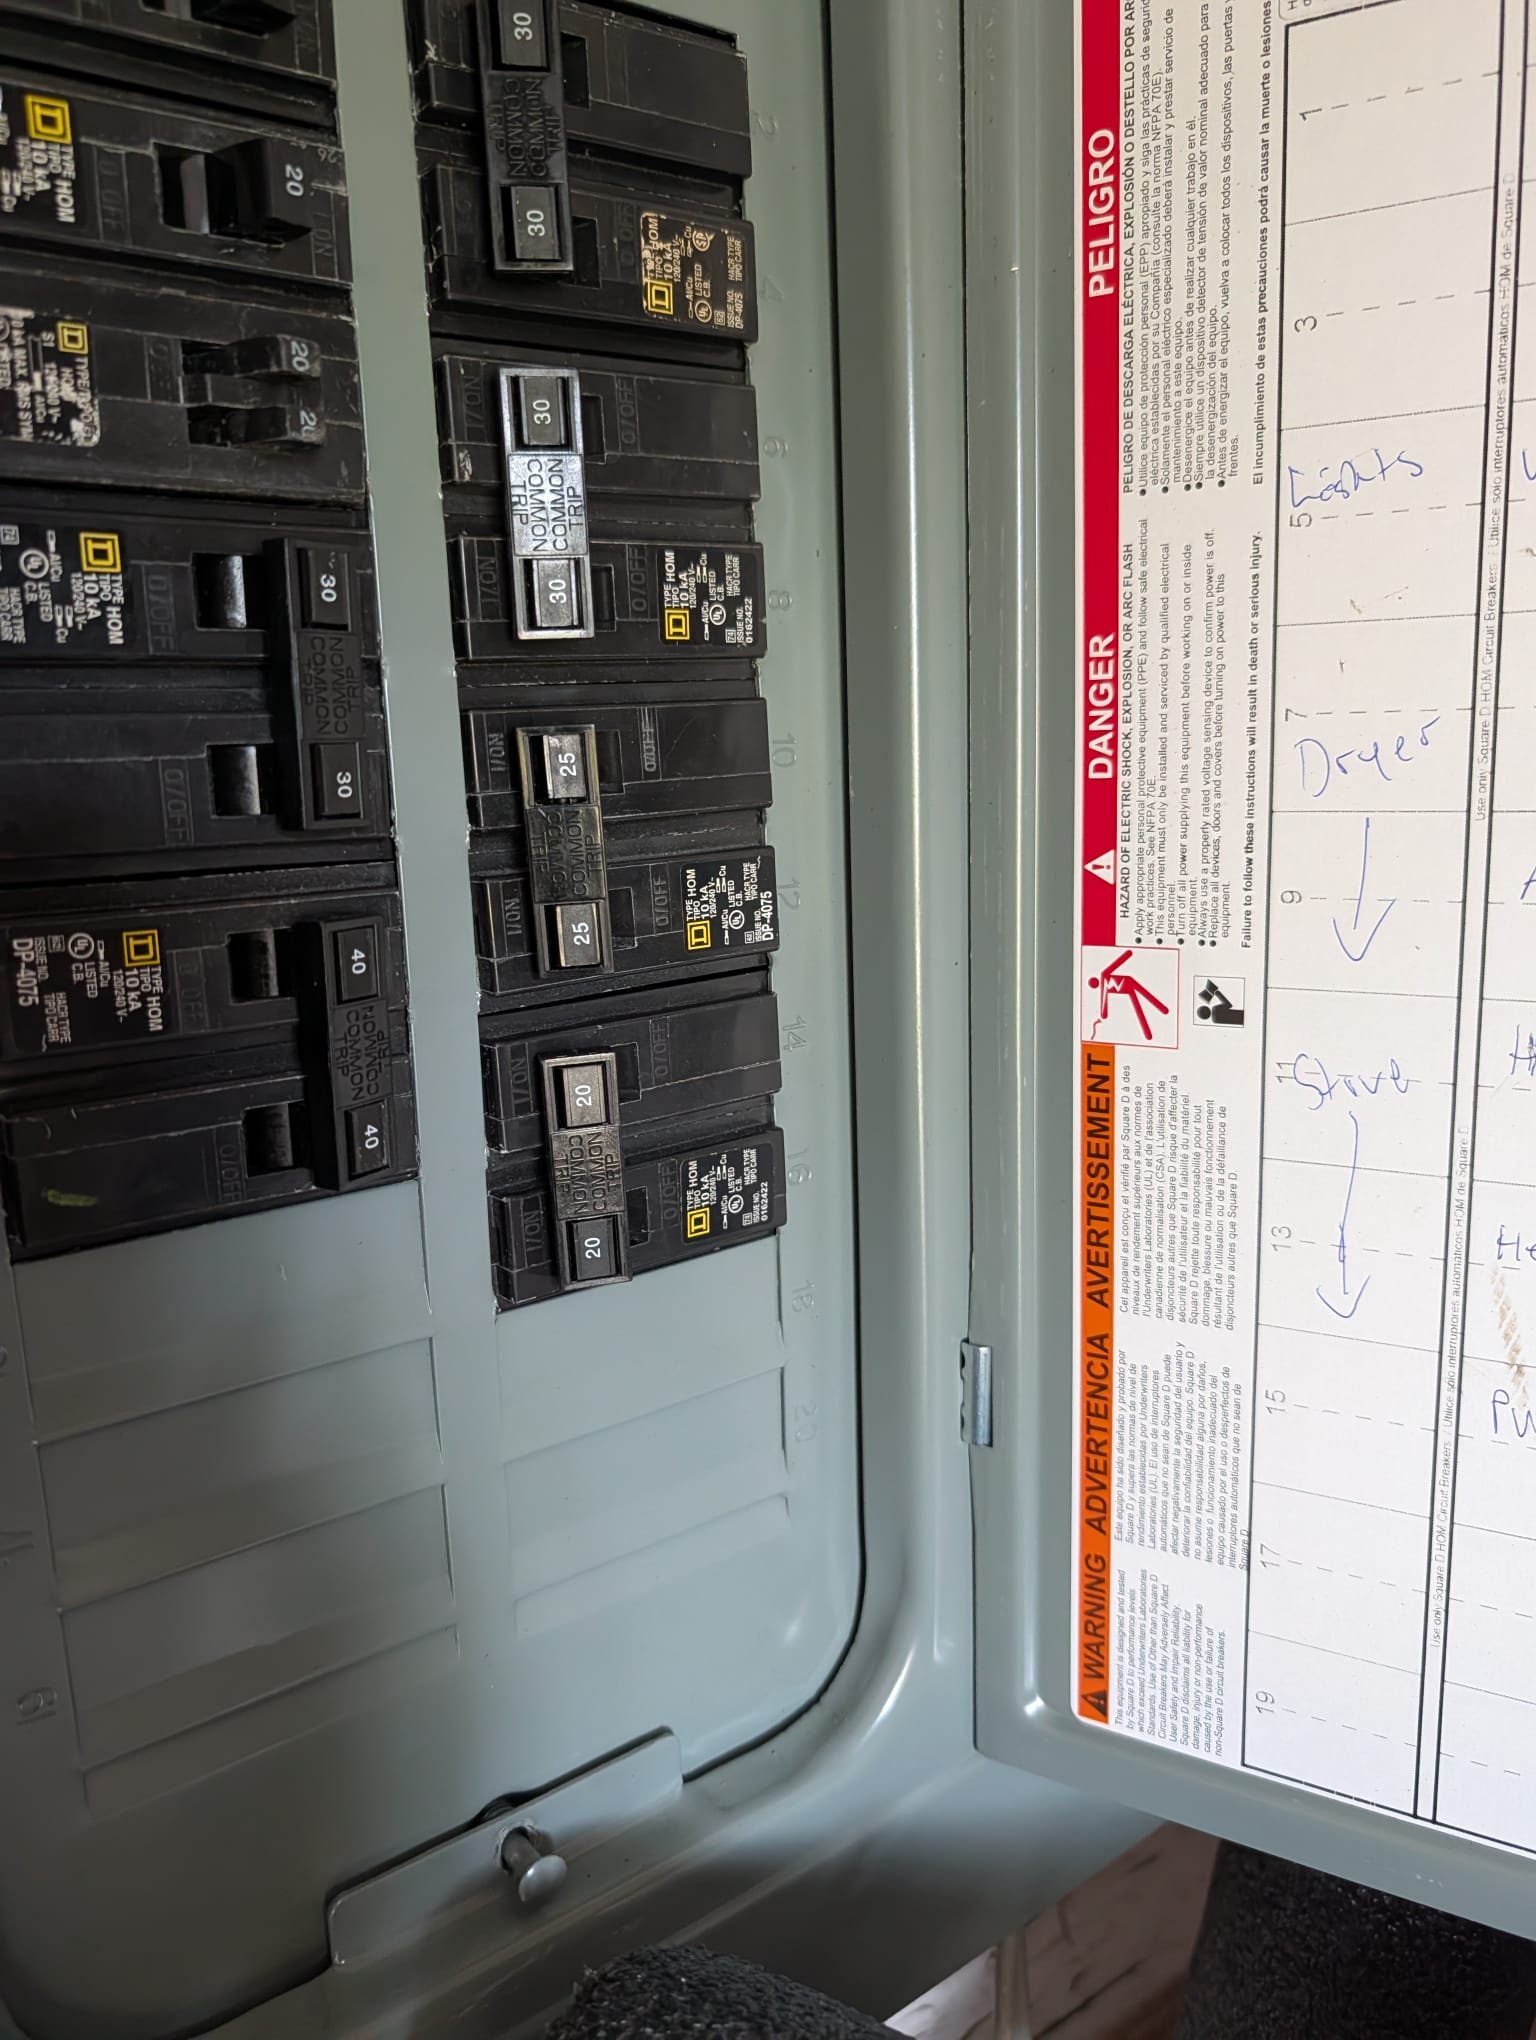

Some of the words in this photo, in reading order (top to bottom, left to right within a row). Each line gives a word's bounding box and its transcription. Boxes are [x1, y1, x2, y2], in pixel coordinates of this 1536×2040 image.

[513, 12, 532, 40] 30
[1261, 1, 1271, 57] lesiones
[1125, 26, 1134, 58] POR
[1263, 61, 1270, 69] o
[1125, 62, 1134, 138] DESTELLO
[1260, 74, 1269, 119] muerte
[1260, 123, 1269, 135] la
[1300, 108, 1321, 121] 1
[1125, 142, 1134, 153] O
[286, 164, 303, 196] 20
[54, 180, 75, 222] HOM
[1088, 128, 1115, 298] PELIGRO
[1123, 157, 1133, 240] EXPLOSIÓN
[1258, 186, 1270, 224] podrá
[526, 210, 546, 236] 30
[1123, 243, 1136, 326] ELÉCTRICA,
[1256, 228, 1269, 314] precauciones
[1256, 318, 1265, 351] estas
[1294, 315, 1317, 333] 3
[290, 341, 309, 372] 20
[1124, 330, 1133, 407] DESCARGA
[1255, 355, 1264, 370] de
[533, 399, 551, 424] 30
[1124, 412, 1133, 430] DE
[1254, 374, 1267, 469] incumplimiento
[1123, 434, 1132, 493] PELIGRO
[1253, 473, 1262, 484] El
[511, 480, 528, 524] TRIP
[528, 458, 548, 552] COMMON
[548, 458, 568, 551] COMMON
[567, 486, 583, 530] TRIP
[1290, 512, 1312, 528] 5
[1138, 520, 1147, 567] electrical
[1250, 532, 1262, 570] injury.
[664, 552, 676, 582] HOM
[700, 553, 707, 566] Cu
[1122, 544, 1131, 587] FLASH
[84, 574, 98, 594] 10
[112, 574, 124, 604] TYPE
[320, 574, 336, 602] 30
[549, 578, 566, 604] 30
[679, 572, 688, 588] kA
[726, 576, 734, 596] HACR
[1137, 571, 1146, 594] safe
[86, 598, 102, 620] kA
[664, 584, 672, 608] TYPE
[672, 587, 680, 608] TIPO
[680, 593, 689, 608] 10
[1122, 592, 1131, 619] ARC
[1249, 574, 1258, 618] serious
[106, 606, 124, 645] HOM
[736, 607, 744, 620] NO.
[744, 598, 753, 644] 0162422
[1137, 597, 1146, 627] follow
[1121, 623, 1130, 642] OR
[1137, 631, 1146, 650] and
[1251, 622, 1257, 634] or
[1247, 638, 1257, 671] death
[1137, 654, 1148, 685] (PPE)
[1247, 675, 1256, 685] in
[1121, 647, 1133, 724] EXPLOSION,
[1088, 632, 1114, 780] DANGER
[1136, 689, 1148, 744] equipment
[1246, 690, 1256, 722] result
[1286, 708, 1306, 722] 7
[1246, 727, 1255, 746] will
[558, 752, 577, 776] 25
[1120, 729, 1132, 777] SHOCK,
[1294, 715, 1441, 798] Dryer
[336, 772, 352, 798] 30
[1136, 747, 1147, 797] protective
[1244, 750, 1254, 819] instructions
[1120, 782, 1129, 842] ELECTRIC
[1136, 800, 1147, 844] personal
[566, 810, 588, 895] COMMON
[1243, 823, 1253, 854] these
[585, 835, 602, 875] TRIP
[1120, 848, 1129, 864] OF
[686, 869, 696, 896] HOM
[1135, 848, 1147, 904] appropriate
[1243, 858, 1252, 892] follow
[700, 886, 708, 900] kA
[1119, 868, 1129, 918] HAZARD
[1242, 896, 1251, 906] to
[1281, 890, 1302, 904] 9
[686, 899, 694, 921] TYPE
[701, 904, 710, 919] 10
[760, 890, 774, 940] DP-4075
[1135, 908, 1146, 935] Apply
[572, 922, 590, 945] 25
[754, 922, 762, 942] ISSUE
[1241, 910, 1251, 948] Failure
[12, 938, 39, 1006] DP-4075
[351, 948, 366, 975] 40
[125, 968, 138, 988] 10
[150, 966, 163, 994] TYPE
[128, 991, 142, 1012] kA
[147, 996, 163, 1032] HOM
[336, 1032, 349, 1077] TRIP
[346, 1010, 364, 1100] COMMON
[1276, 1062, 1296, 1084] 11
[575, 1084, 592, 1106] 20
[364, 1124, 380, 1149] 40
[588, 1132, 606, 1210] COMMON
[605, 1154, 620, 1190] TRIP
[688, 1160, 698, 1187] HOM
[700, 1174, 709, 1190] kA
[1086, 1052, 1110, 1308] AVERTISSEMENT
[1227, 1170, 1236, 1180] D.
[701, 1192, 710, 1207] 10
[760, 1182, 768, 1221] 0162422
[1227, 1183, 1238, 1218] Square
[1229, 1221, 1238, 1240] que
[1272, 1225, 1292, 1252] 13
[584, 1238, 600, 1258] 20
[1226, 1242, 1235, 1271] autres
[1225, 1274, 1237, 1331] disjoncteurs
[1265, 1390, 1286, 1414] 15
[1085, 1332, 1109, 1534] ADVERTENCIA
[1260, 1544, 1280, 1569] 17
[1159, 1584, 1168, 1609] Affect
[1084, 1553, 1106, 1680] WARNING
[1159, 1610, 1170, 1653] Adversely
[1158, 1653, 1170, 1673] May
[1158, 1673, 1167, 1712] Breakers
[1255, 1691, 1275, 1714] 19
[1157, 1712, 1167, 1739] Circuit
